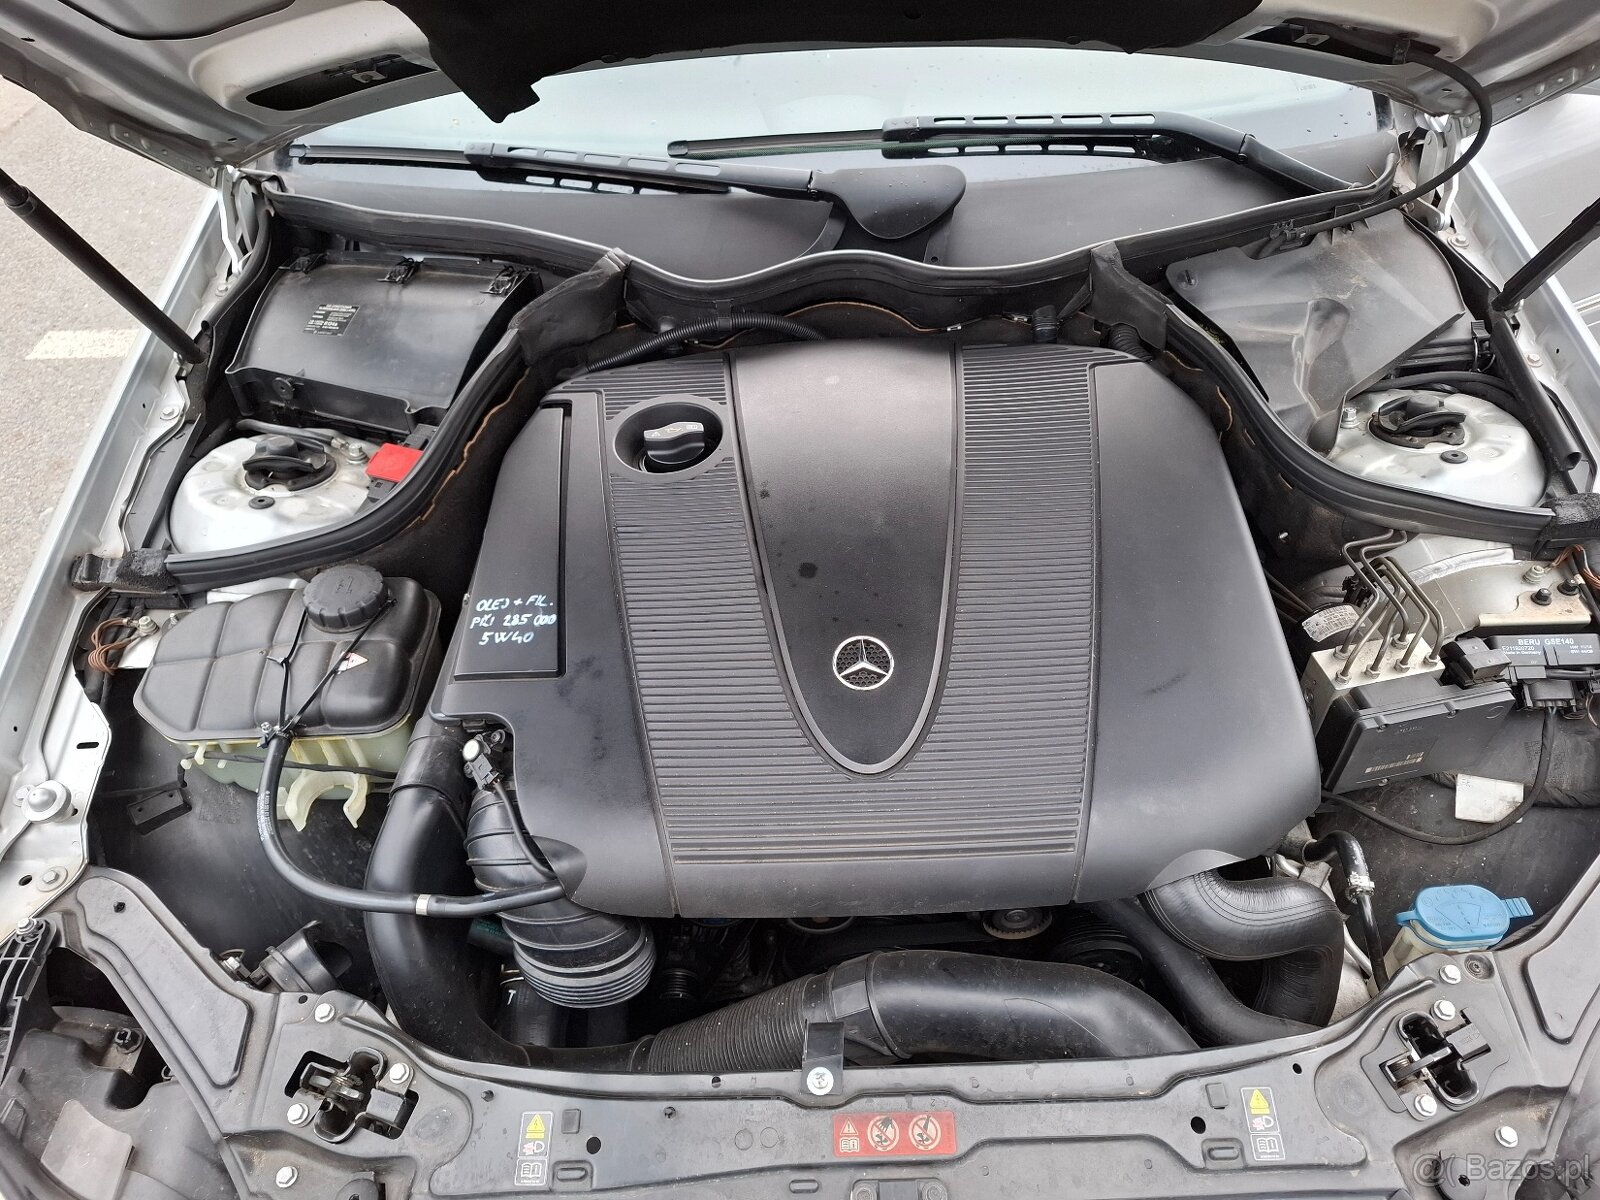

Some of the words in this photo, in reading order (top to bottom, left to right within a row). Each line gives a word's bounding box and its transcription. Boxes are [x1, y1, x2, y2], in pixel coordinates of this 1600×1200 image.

[476, 598, 510, 611] OLEJ
[513, 598, 523, 606] +
[503, 614, 532, 626] 285
[533, 613, 557, 627] 000
[478, 631, 534, 645] 5W40
